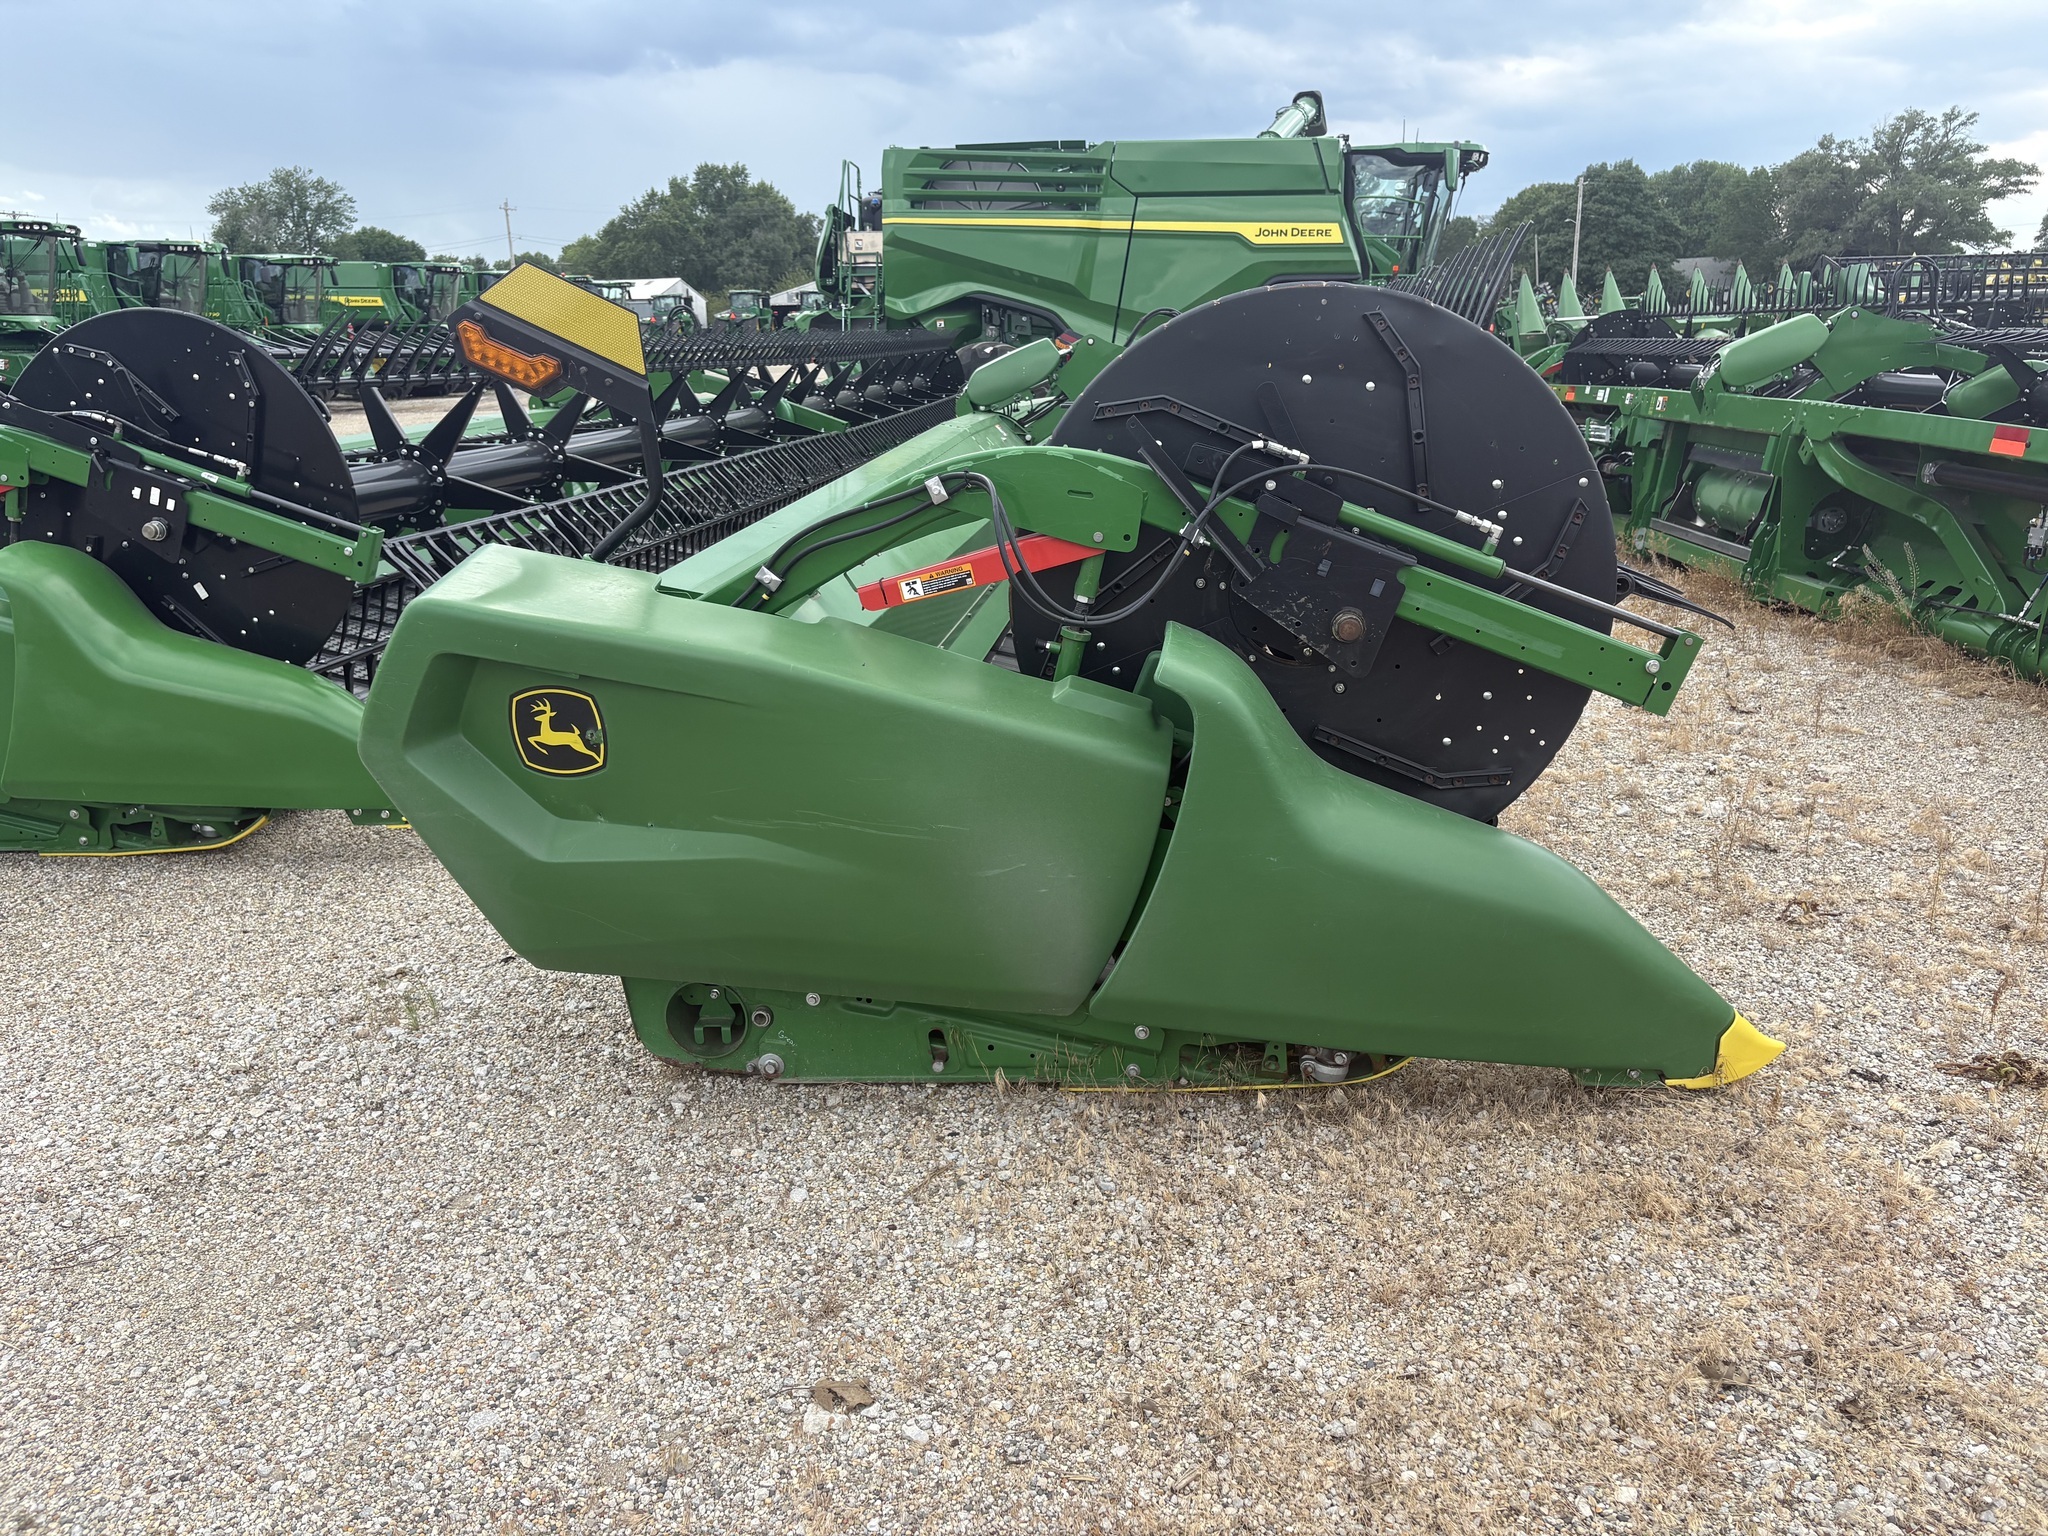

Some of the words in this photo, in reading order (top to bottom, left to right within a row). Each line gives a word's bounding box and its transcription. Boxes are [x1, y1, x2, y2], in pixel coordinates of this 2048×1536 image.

[1255, 227, 1288, 237] JOHN
[1291, 227, 1332, 237] DEERE
[935, 566, 964, 577] WARNING
